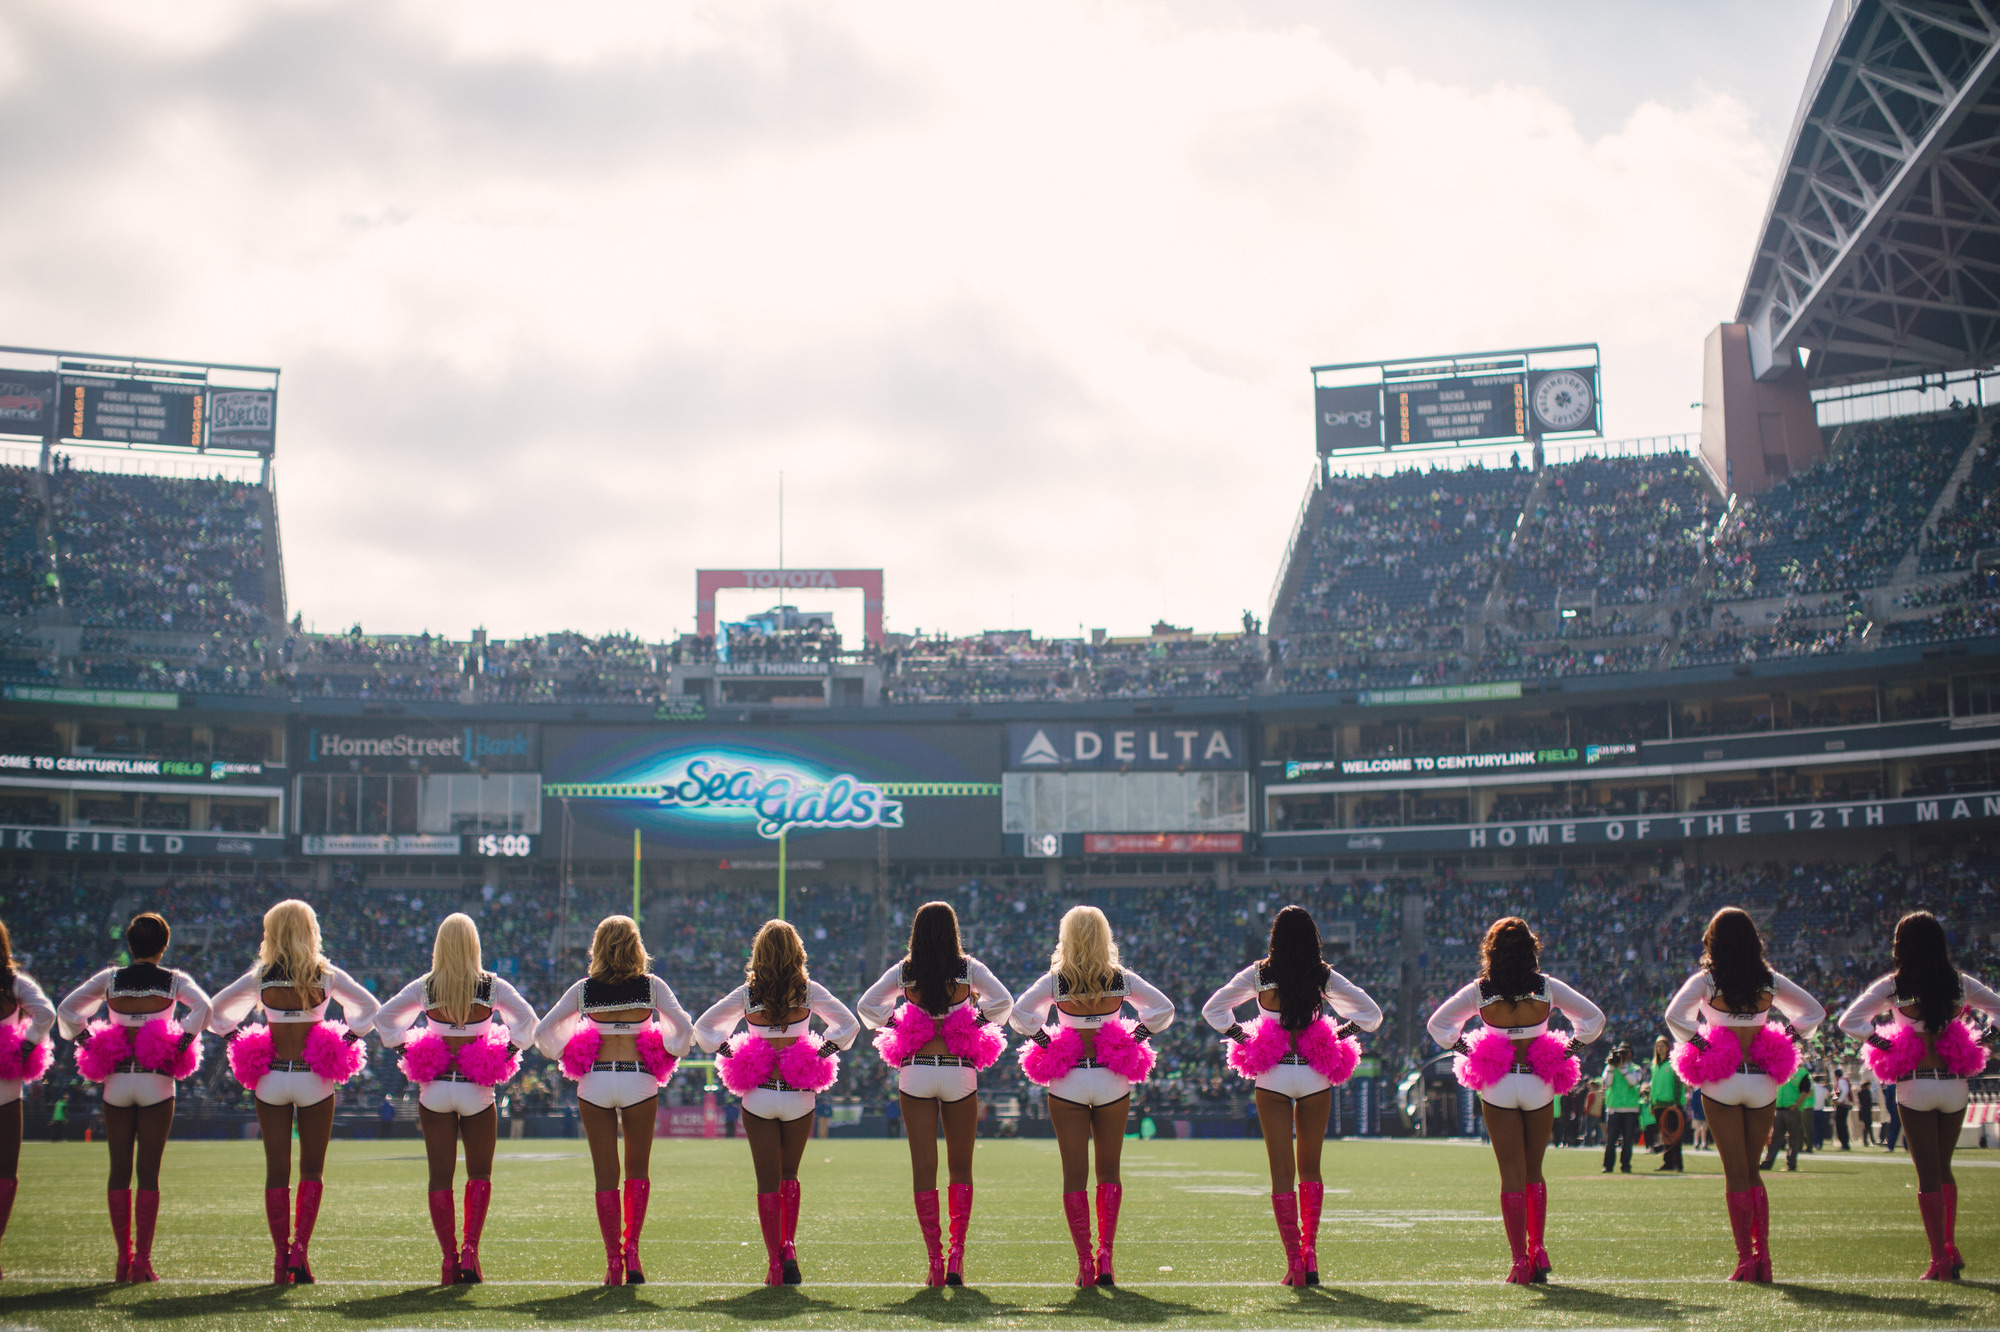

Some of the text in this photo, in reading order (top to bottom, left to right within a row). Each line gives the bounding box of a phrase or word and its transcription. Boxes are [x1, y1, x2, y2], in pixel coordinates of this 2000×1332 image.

[103, 391, 128, 402] FIRST
[97, 402, 166, 417] PASSING YARDS
[137, 417, 166, 429] YARDS
[1324, 409, 1372, 428] bing
[1426, 412, 1485, 427] THREE AND OUT
[130, 429, 159, 441] YARDS
[1431, 425, 1480, 439] TAKEAWAYS
[743, 571, 837, 587] TOYOTA
[715, 664, 829, 675] BLUE THUNDER
[476, 732, 529, 756] Bank
[1074, 730, 1233, 760] DELTA
[33, 757, 55, 770] TO
[57, 757, 161, 775] CENTURYLINK
[162, 761, 205, 775] FIELD
[1342, 758, 1412, 774] WELCOME
[1414, 757, 1435, 771] TO
[1436, 751, 1536, 770] CENTURYLINK
[1538, 748, 1578, 763] FIELD
[1470, 796, 2000, 848] HOME OF THE 12TH MAN
[66, 832, 185, 854] FIELD
[478, 833, 531, 857] 15:00
